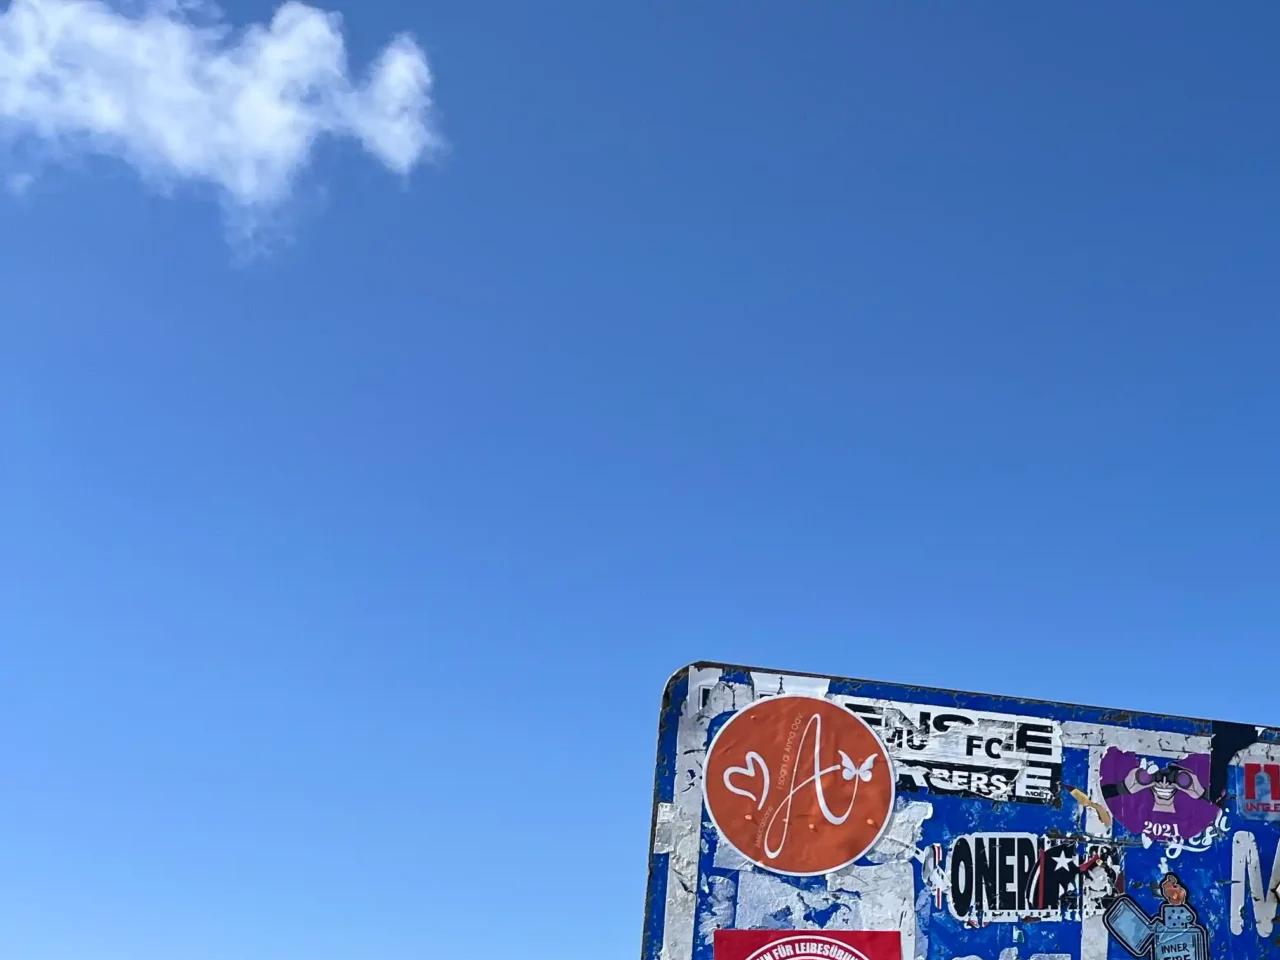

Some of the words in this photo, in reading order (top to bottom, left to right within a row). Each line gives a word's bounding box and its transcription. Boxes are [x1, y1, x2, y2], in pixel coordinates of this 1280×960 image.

[784, 731, 797, 753] Anna
[1143, 821, 1180, 836] 2021
[772, 944, 794, 960] FÜR
[1160, 943, 1188, 954] INNER
